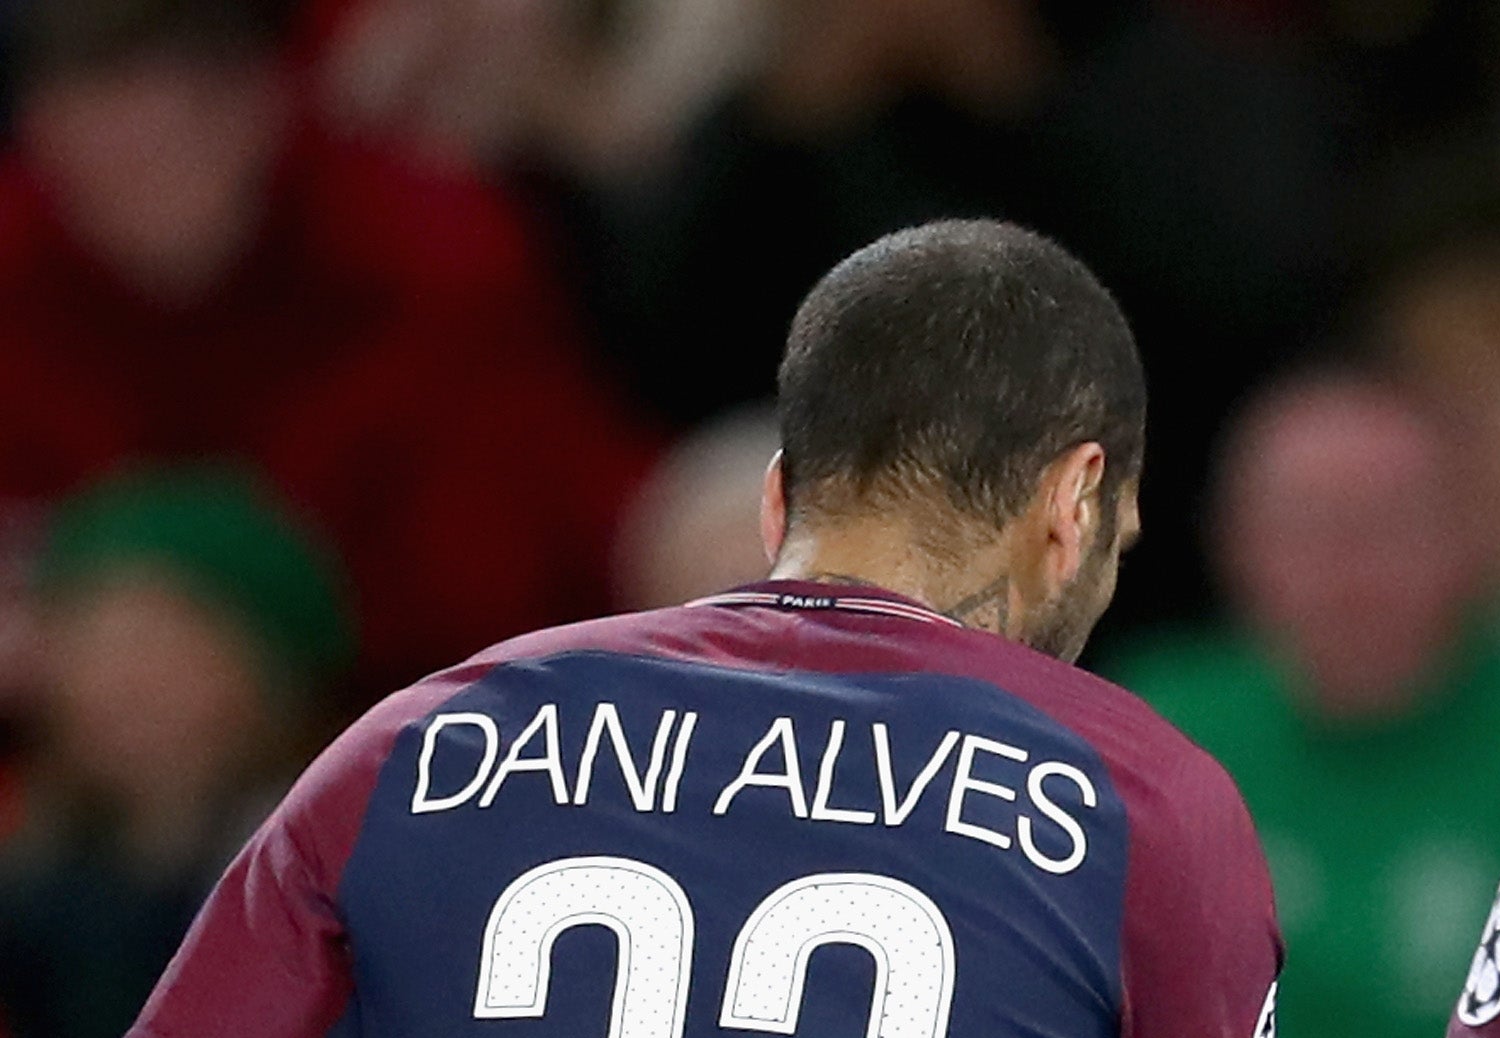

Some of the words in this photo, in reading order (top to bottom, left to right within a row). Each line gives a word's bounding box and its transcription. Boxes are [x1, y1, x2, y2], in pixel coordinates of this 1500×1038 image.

[782, 594, 830, 608] PARIS
[411, 704, 697, 814] DANI
[714, 717, 1097, 874] ALVES
